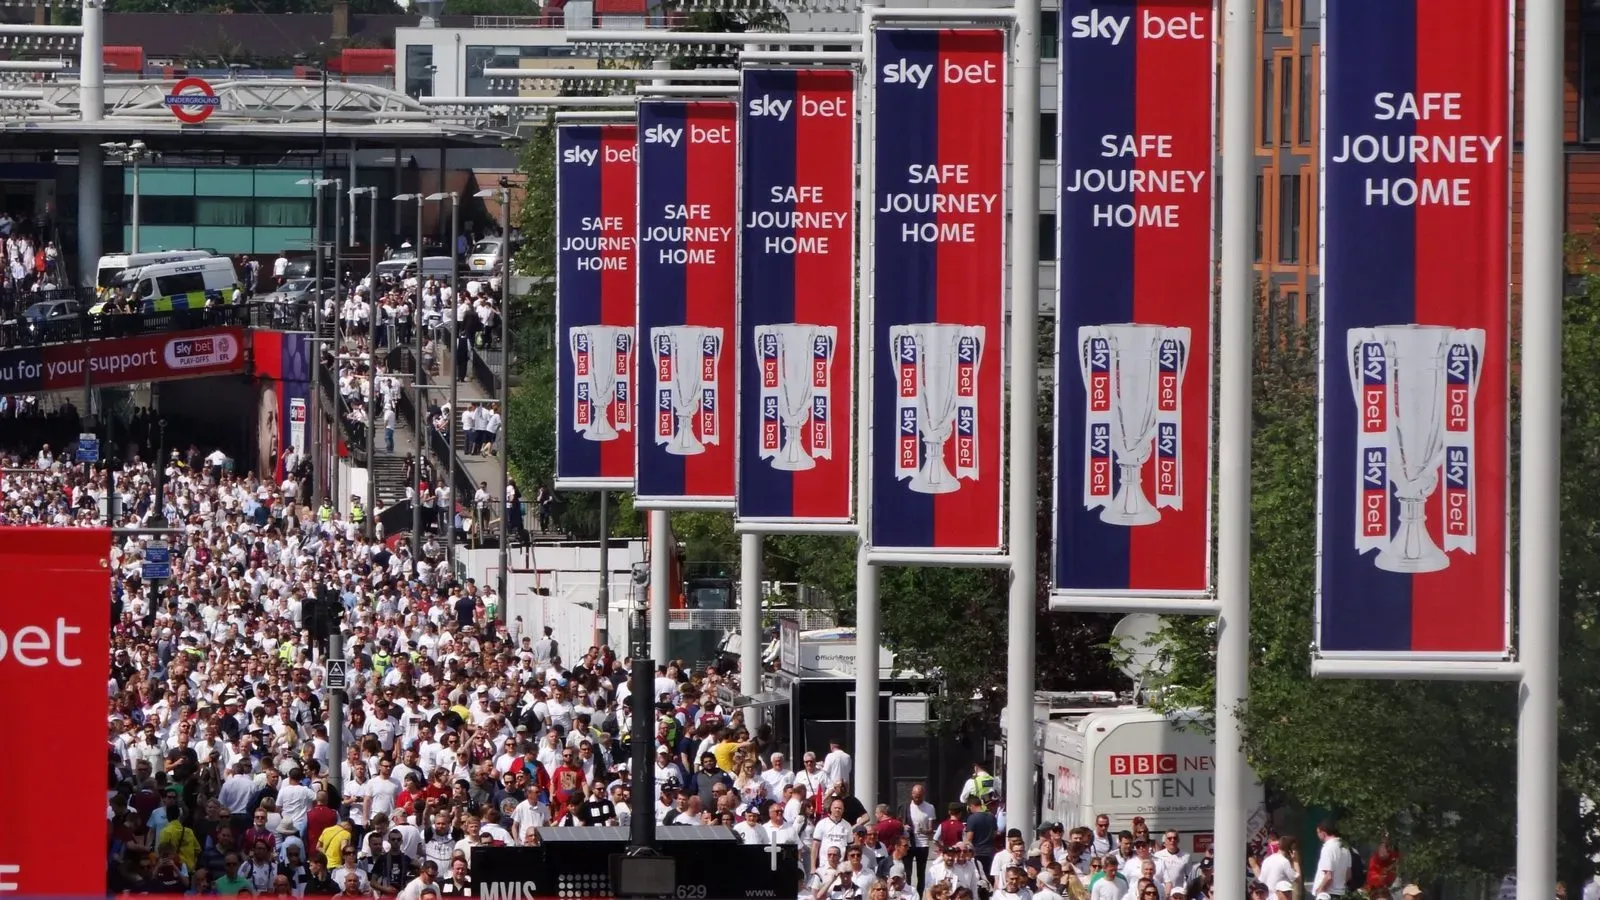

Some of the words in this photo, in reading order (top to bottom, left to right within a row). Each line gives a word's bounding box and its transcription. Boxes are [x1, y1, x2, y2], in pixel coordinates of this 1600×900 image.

[1072, 9, 1130, 45] sky
[1144, 10, 1204, 39] bet
[883, 58, 933, 89] sky
[945, 59, 996, 83] bet
[750, 94, 792, 121] sky
[802, 95, 846, 116] bet
[1375, 92, 1461, 120] SAFE
[645, 124, 682, 147] sky
[691, 124, 730, 143] bet
[1101, 135, 1172, 157] SAFE
[564, 145, 598, 166] sky
[1333, 135, 1502, 163] JOURNEY
[909, 164, 968, 183] SAFE
[1067, 169, 1205, 192] JOURNEY
[771, 186, 823, 203] SAFE
[1366, 178, 1470, 205] HOME
[665, 205, 710, 219] SAFE
[880, 194, 997, 212] JOURNEY
[582, 217, 622, 230] SAFE
[747, 212, 847, 228] JOURNEY
[1094, 205, 1179, 227] HOME
[643, 227, 731, 241] JOURNEY
[903, 223, 974, 242] HOME
[766, 237, 828, 253] HOME
[578, 257, 627, 270] HOME
[660, 249, 715, 264] HOME
[176, 342, 192, 357] sky
[195, 340, 212, 352] bet
[578, 334, 588, 353] sky
[659, 336, 670, 355] sky
[765, 334, 777, 356] sky
[902, 337, 916, 362] sky
[1092, 340, 1109, 368] sky
[18, 360, 42, 379] for
[47, 359, 85, 380] your
[90, 348, 157, 374] support
[180, 356, 209, 364] PLAY-OFFS
[578, 355, 587, 374] bet
[617, 354, 626, 372] bet
[660, 360, 670, 379] bet
[705, 360, 713, 379] bet
[1365, 345, 1384, 381] sky
[766, 361, 776, 385] bet
[816, 361, 826, 384] bet
[904, 368, 914, 394] bet
[962, 368, 972, 392] bet
[578, 383, 589, 401] sky
[616, 383, 627, 401] sky
[660, 391, 671, 410] sky
[703, 390, 714, 410] sky
[1094, 377, 1107, 407] bet
[1162, 376, 1175, 406] bet
[579, 404, 587, 422] bet
[617, 403, 626, 421] bet
[765, 398, 777, 420] sky
[814, 397, 826, 420] sky
[1368, 391, 1383, 427] bet
[1452, 390, 1467, 426] bet
[660, 414, 670, 434] bet
[705, 413, 713, 433] bet
[902, 410, 916, 433] sky
[959, 409, 973, 433] sky
[766, 424, 776, 447] bet
[816, 424, 825, 446] bet
[1092, 426, 1109, 454] sky
[1159, 426, 1176, 454] sky
[904, 441, 914, 465] bet
[961, 440, 971, 464] bet
[1094, 462, 1107, 492] bet
[1162, 462, 1174, 491] bet
[1365, 450, 1386, 486] sky
[1448, 450, 1468, 485] sky
[1368, 495, 1383, 531] bet
[1451, 494, 1466, 530] bet
[0, 617, 82, 667] et
[1111, 754, 1177, 774] BBC
[1111, 779, 1194, 798] LISTEN
